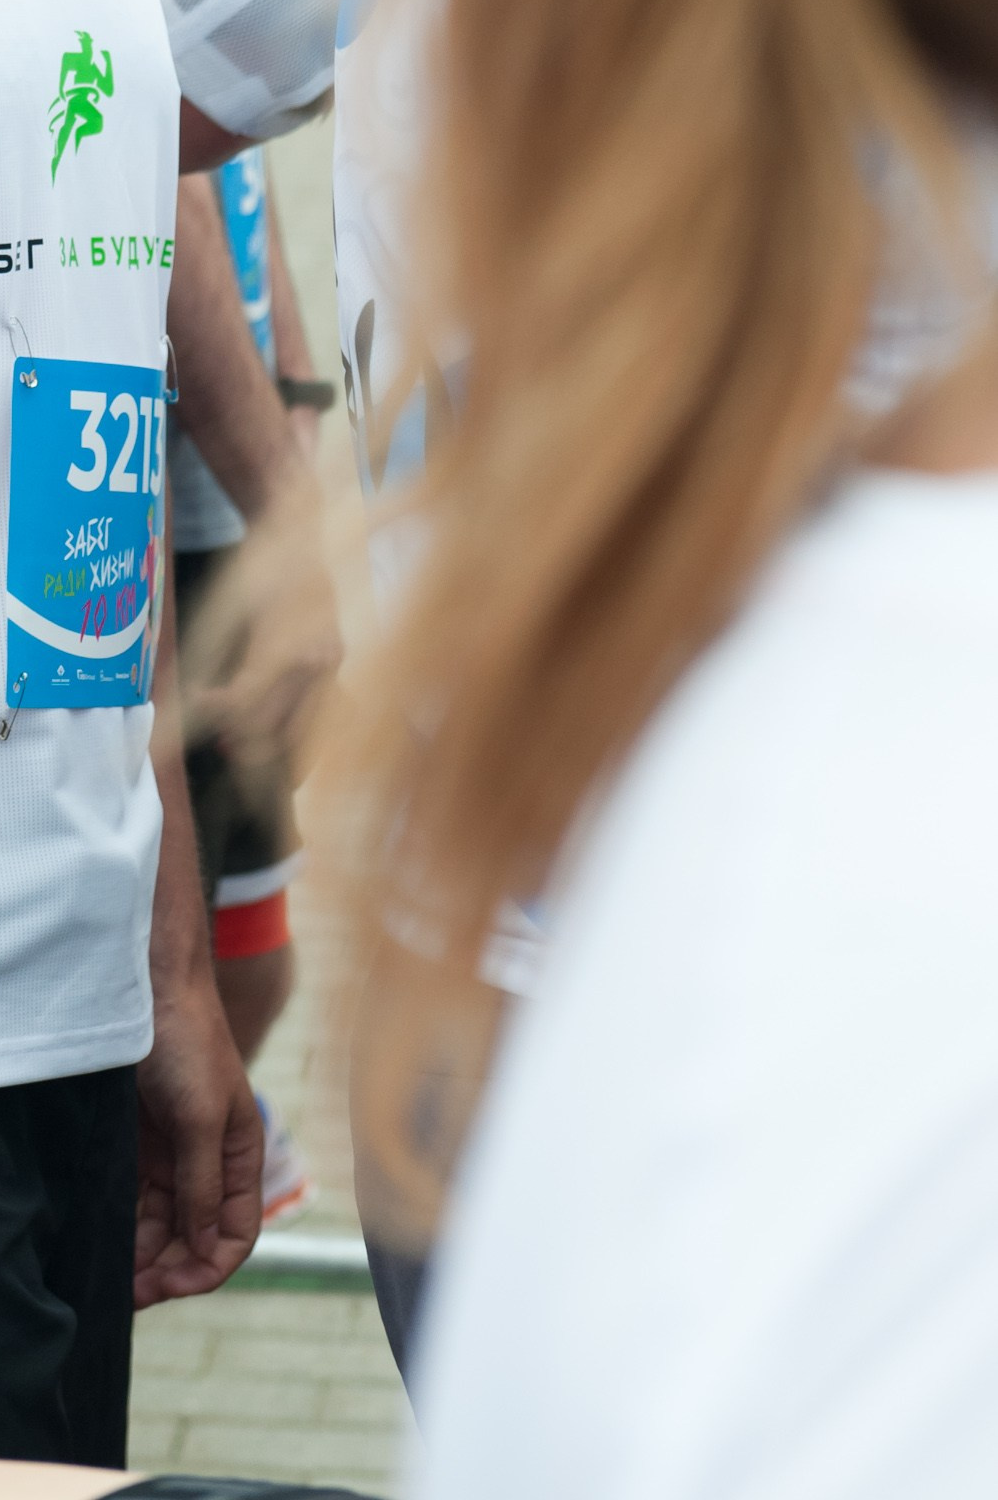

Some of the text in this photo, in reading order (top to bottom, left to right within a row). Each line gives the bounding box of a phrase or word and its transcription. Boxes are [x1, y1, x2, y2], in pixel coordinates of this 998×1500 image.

[59, 236, 79, 267] ЗА
[90, 236, 175, 270] БУДУЕ
[67, 389, 165, 497] 3213
[64, 516, 113, 561] ЗАБЕГ
[43, 567, 86, 599] РАДИ
[81, 593, 107, 643] 10
